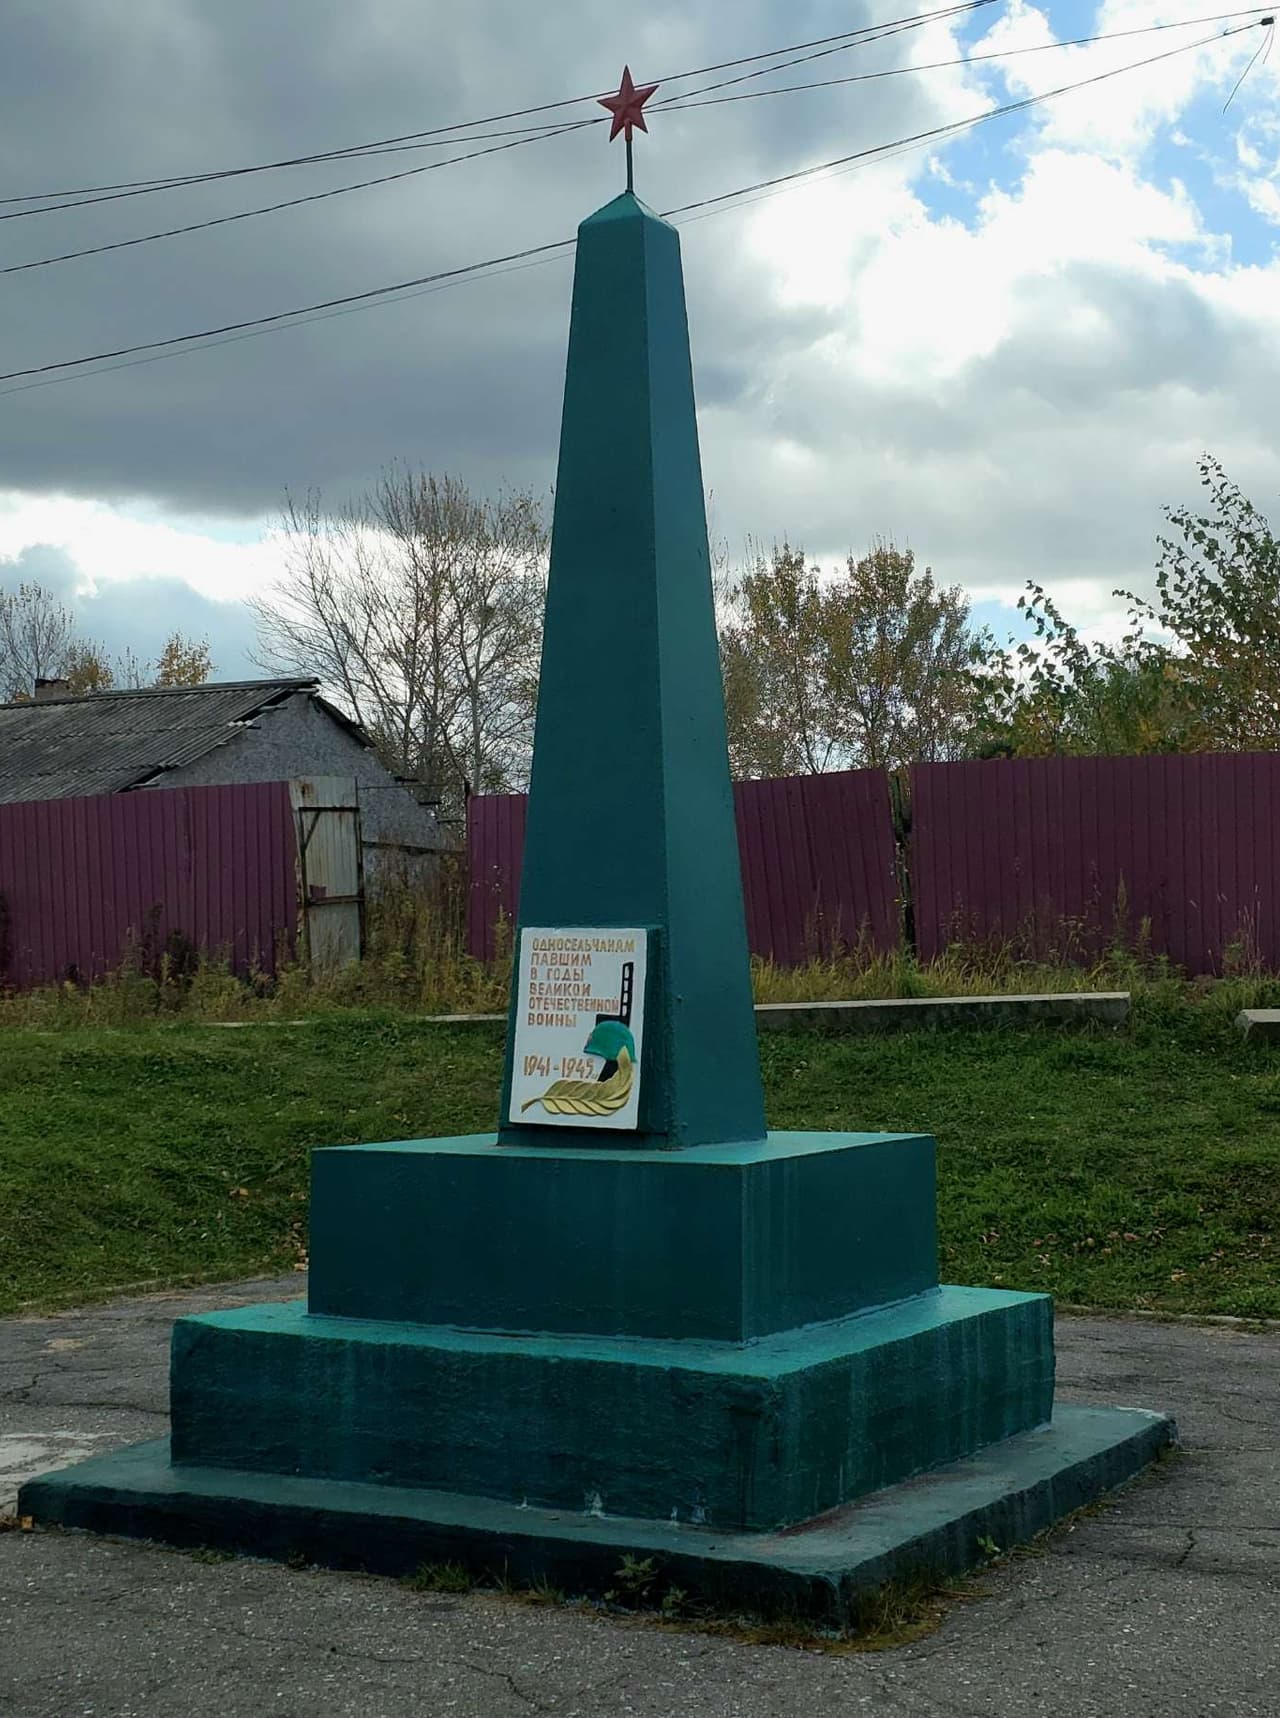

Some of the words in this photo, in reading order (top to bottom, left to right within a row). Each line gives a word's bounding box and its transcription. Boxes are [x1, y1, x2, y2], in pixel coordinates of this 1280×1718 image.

[531, 953, 592, 966] ПАВШИМ
[530, 968, 538, 980] В
[547, 968, 584, 981] ГОДЫ
